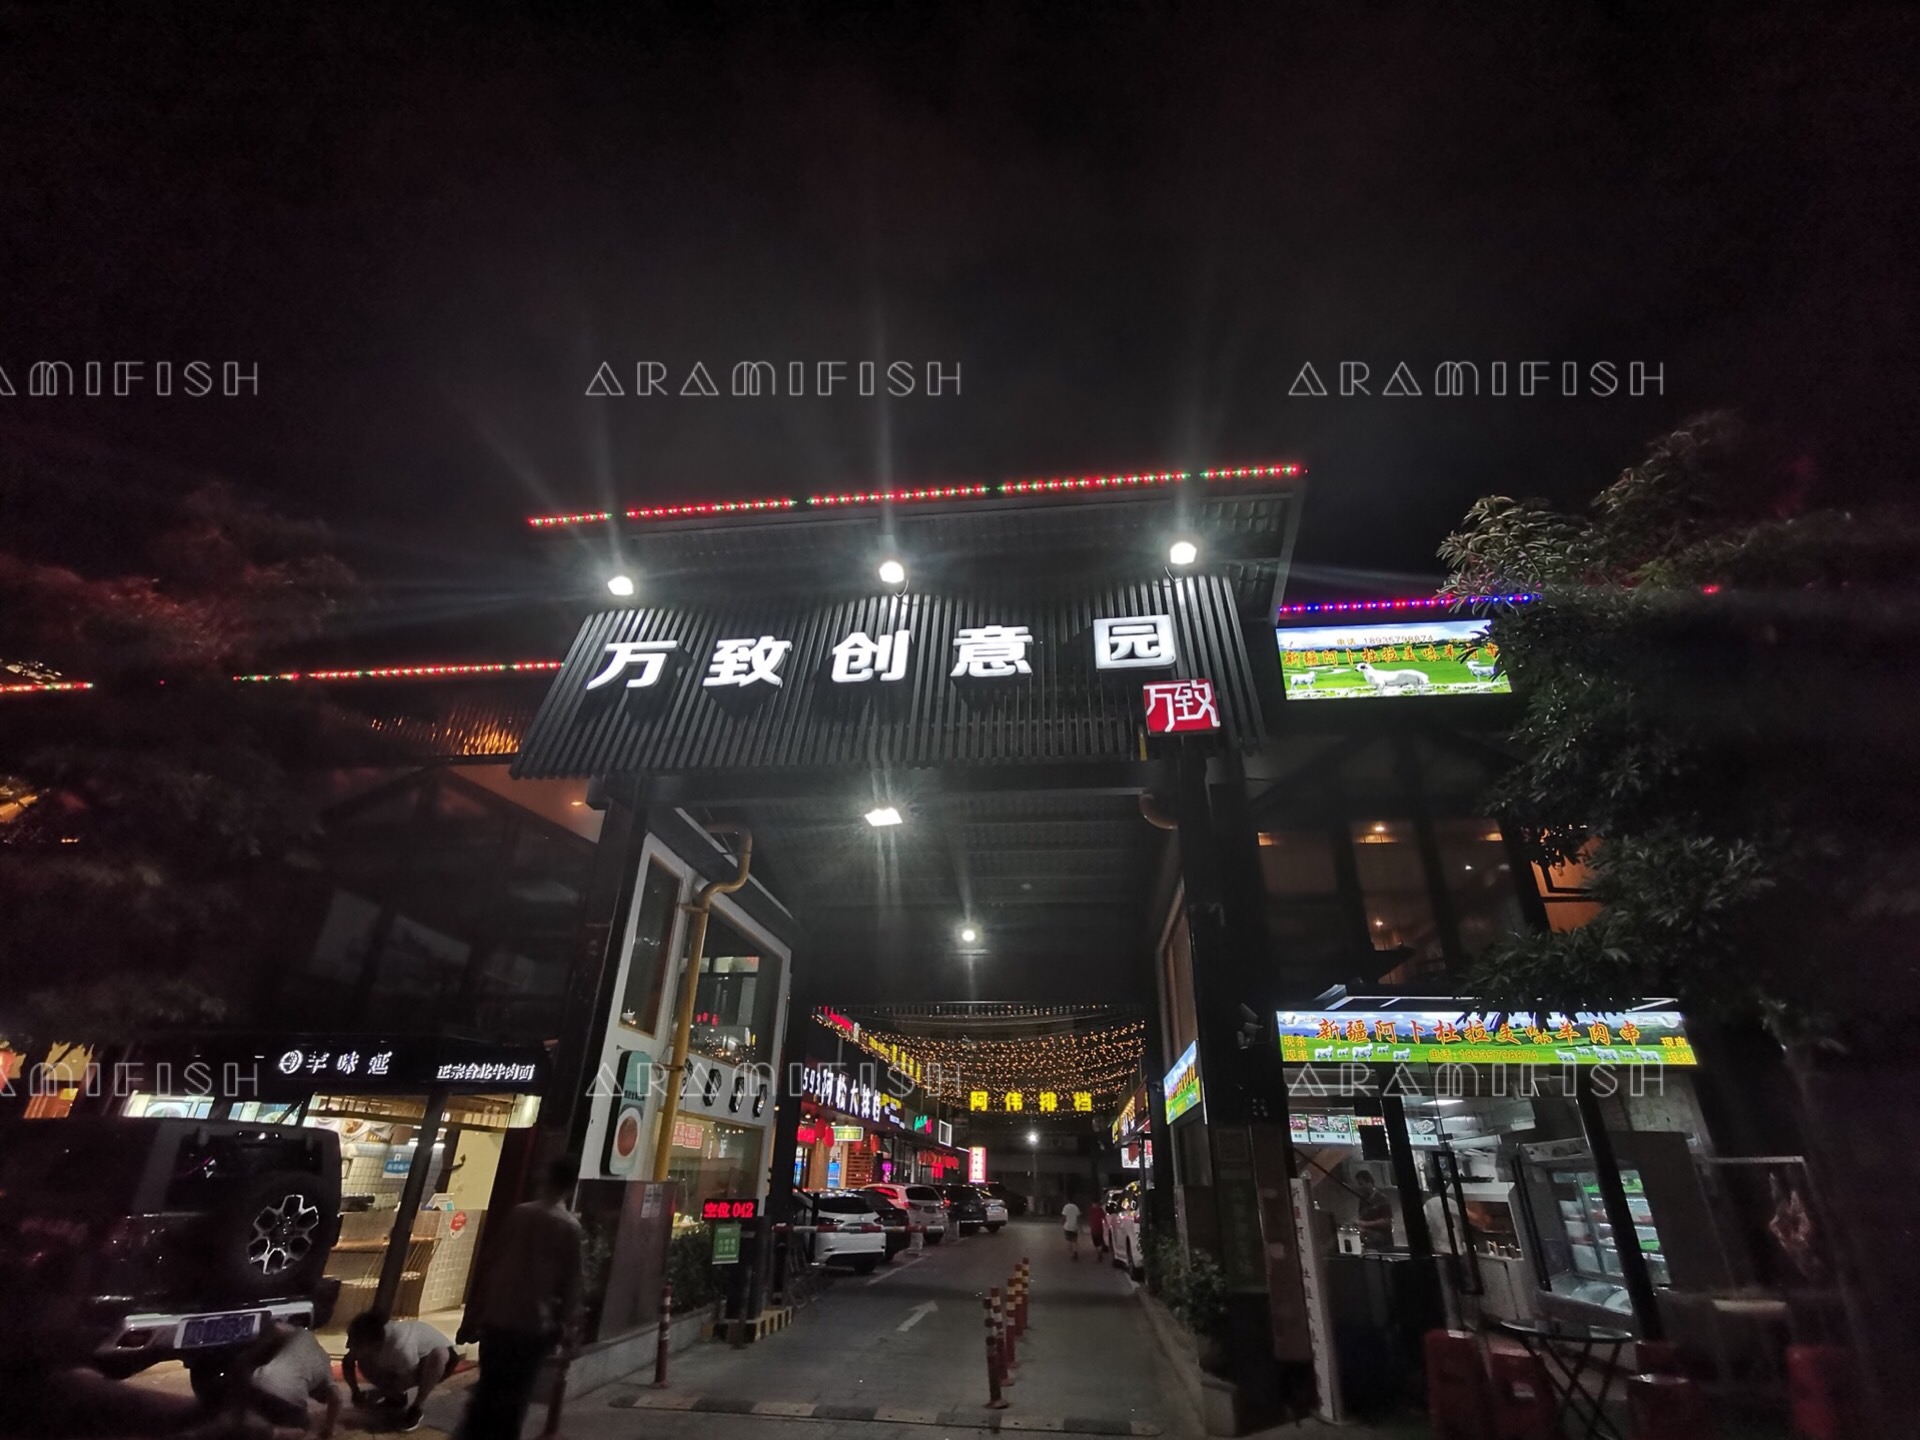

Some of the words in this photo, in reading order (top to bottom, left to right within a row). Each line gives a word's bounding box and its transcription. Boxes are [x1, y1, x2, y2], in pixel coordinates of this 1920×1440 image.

[586, 614, 1178, 691] 万致创意园
[1143, 680, 1221, 732] 万致
